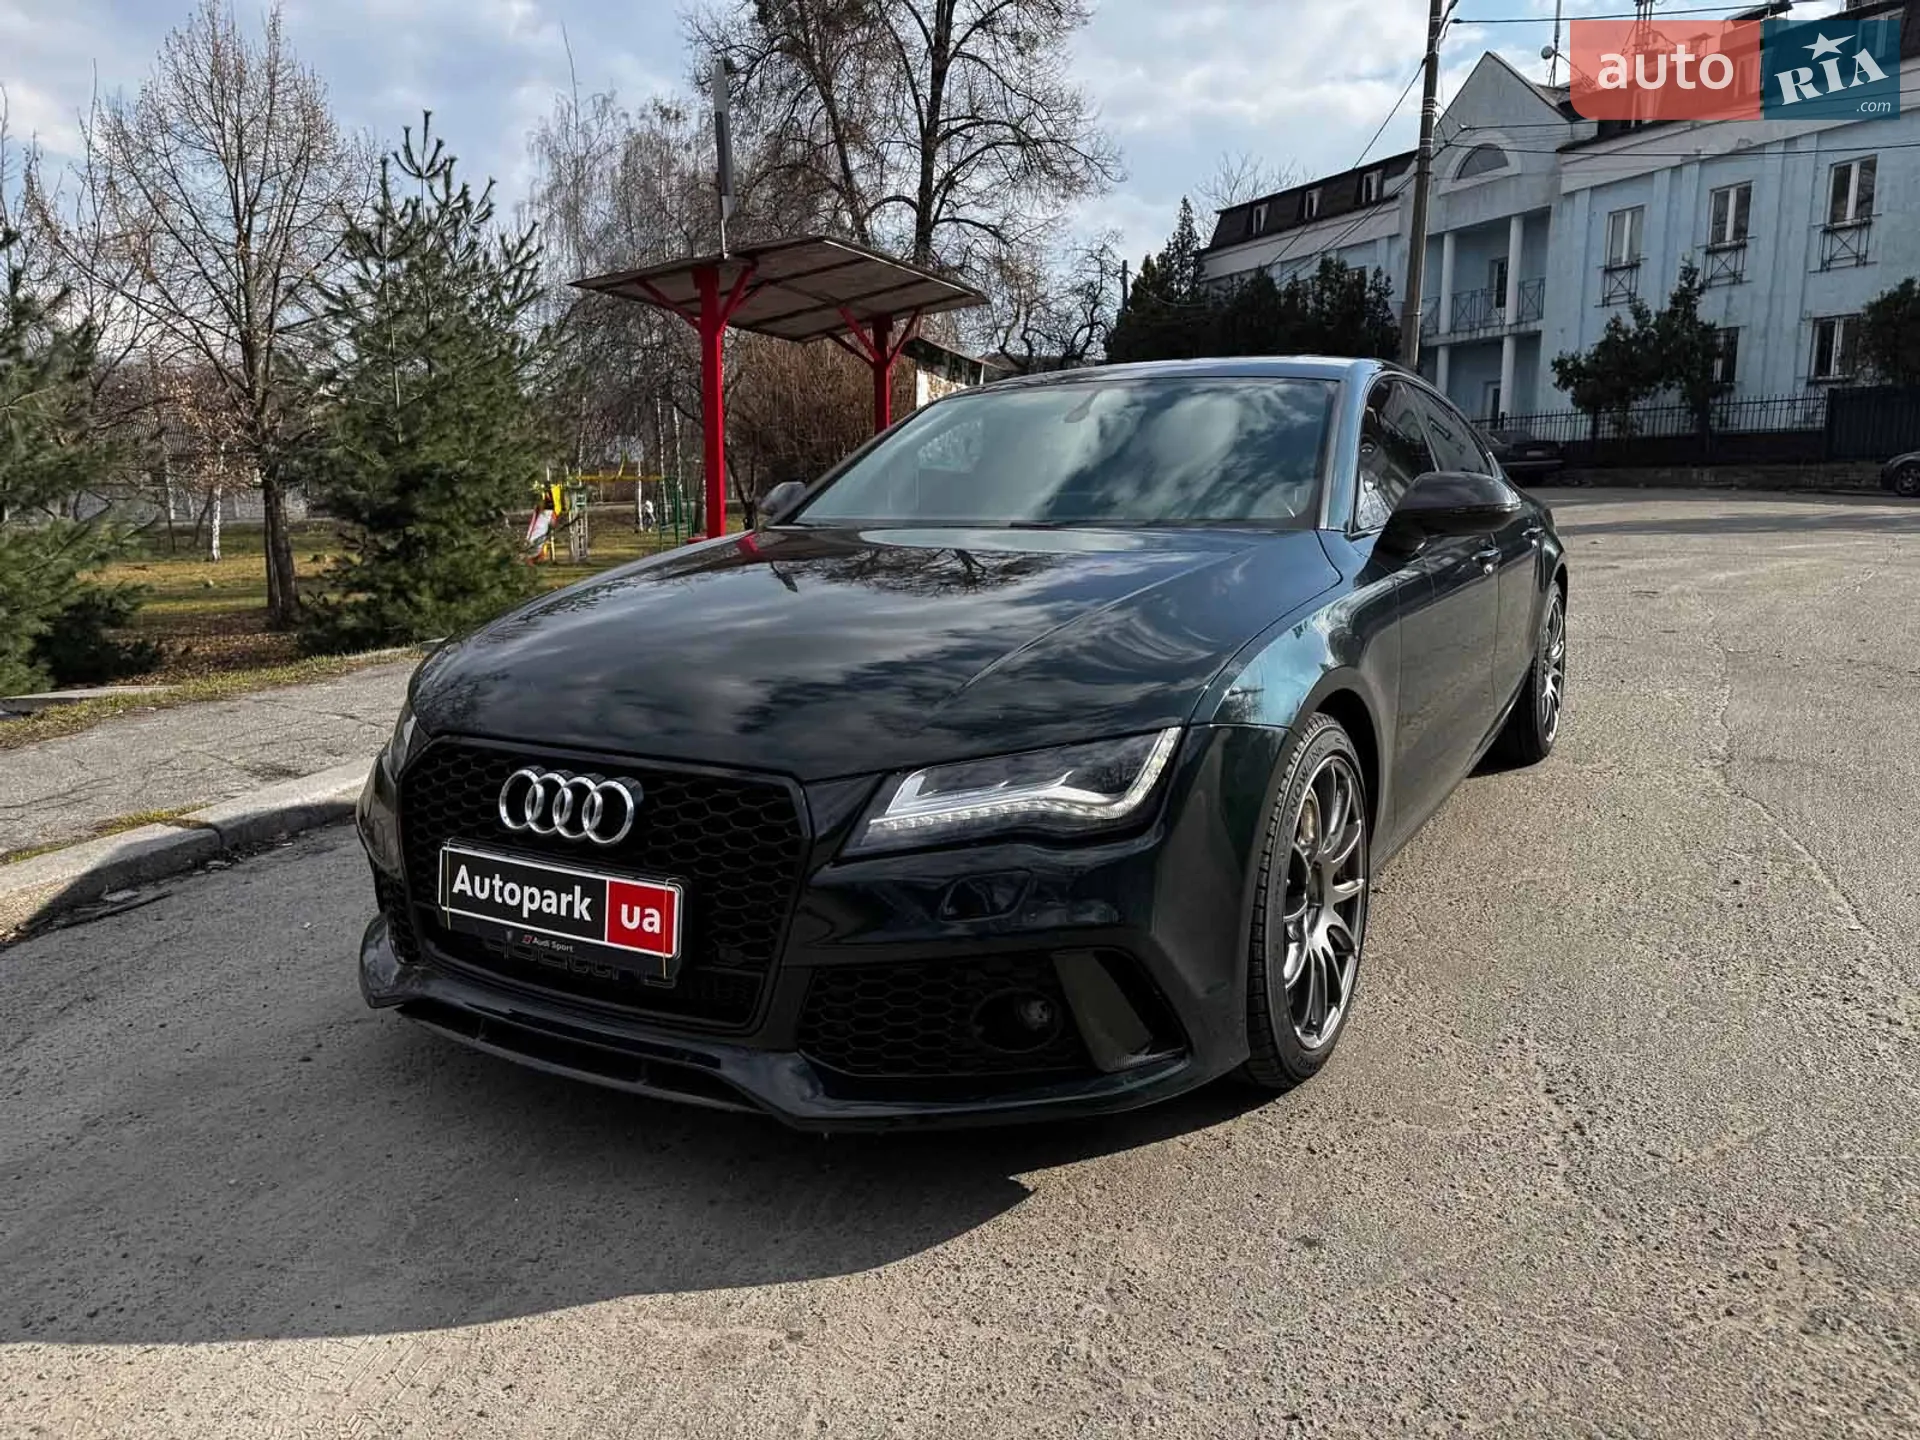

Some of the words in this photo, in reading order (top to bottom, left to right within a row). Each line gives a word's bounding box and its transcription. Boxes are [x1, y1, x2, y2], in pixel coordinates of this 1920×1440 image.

[452, 864, 592, 922] Autopark
[620, 903, 661, 934] ua
[551, 940, 574, 953] Sport
